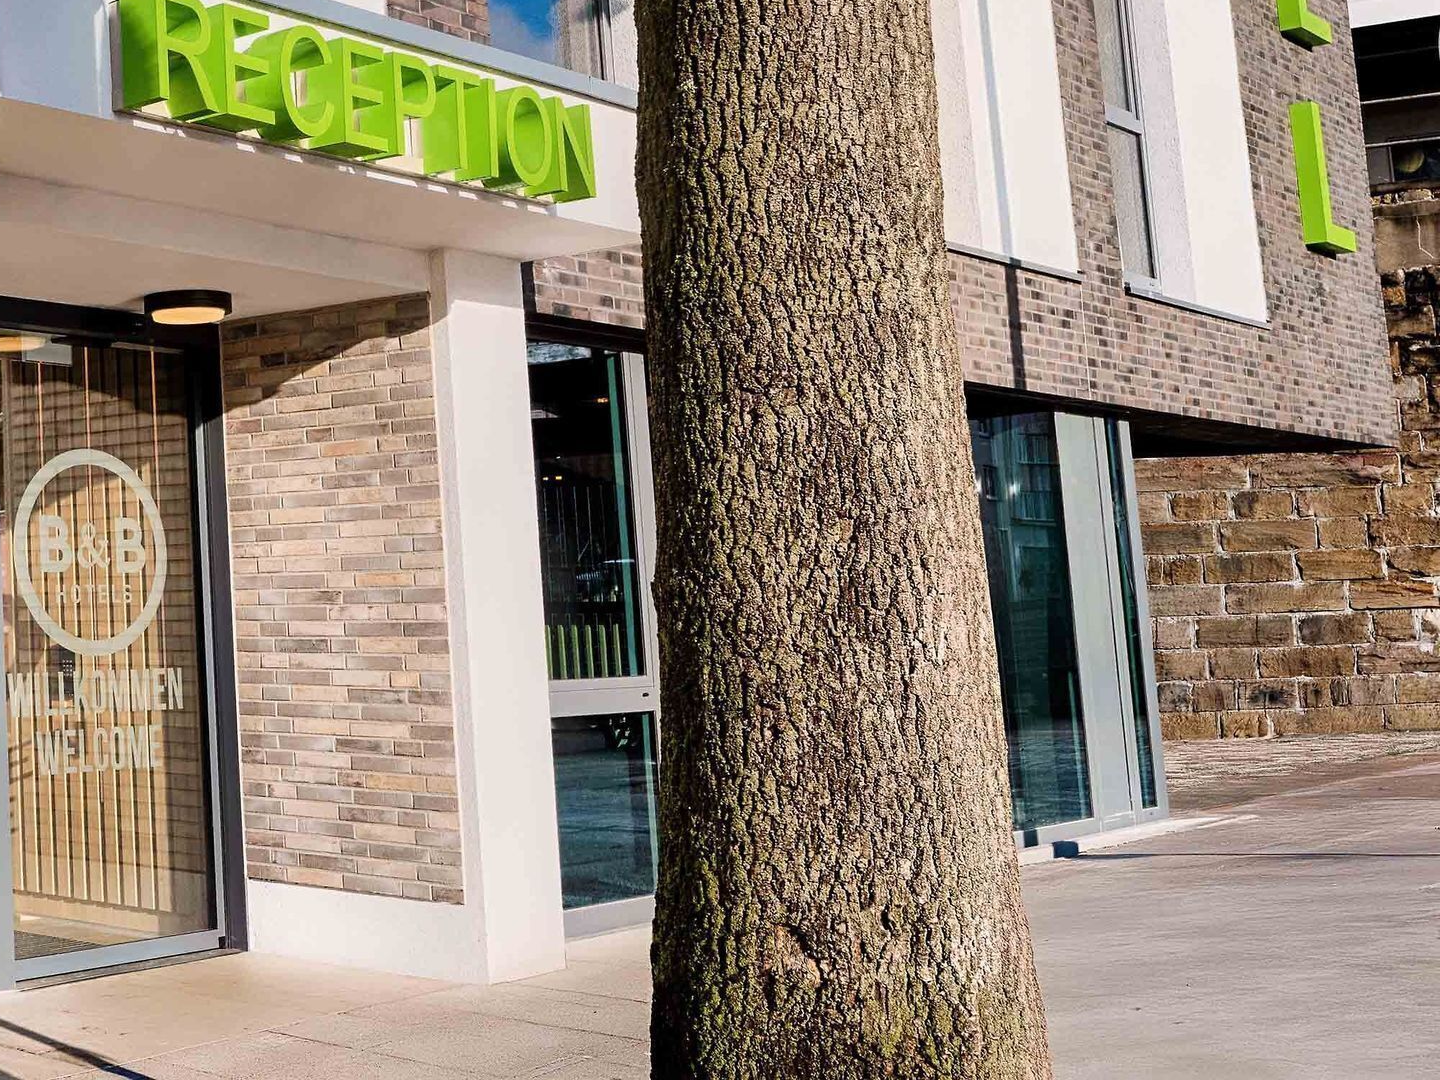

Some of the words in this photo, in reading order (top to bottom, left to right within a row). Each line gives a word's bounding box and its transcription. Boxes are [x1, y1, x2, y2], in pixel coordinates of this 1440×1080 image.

[39, 514, 146, 573] B&B
[55, 584, 133, 604] HOTELS
[7, 667, 184, 718] WILLKOMMEN
[36, 724, 163, 775] WELCOME
